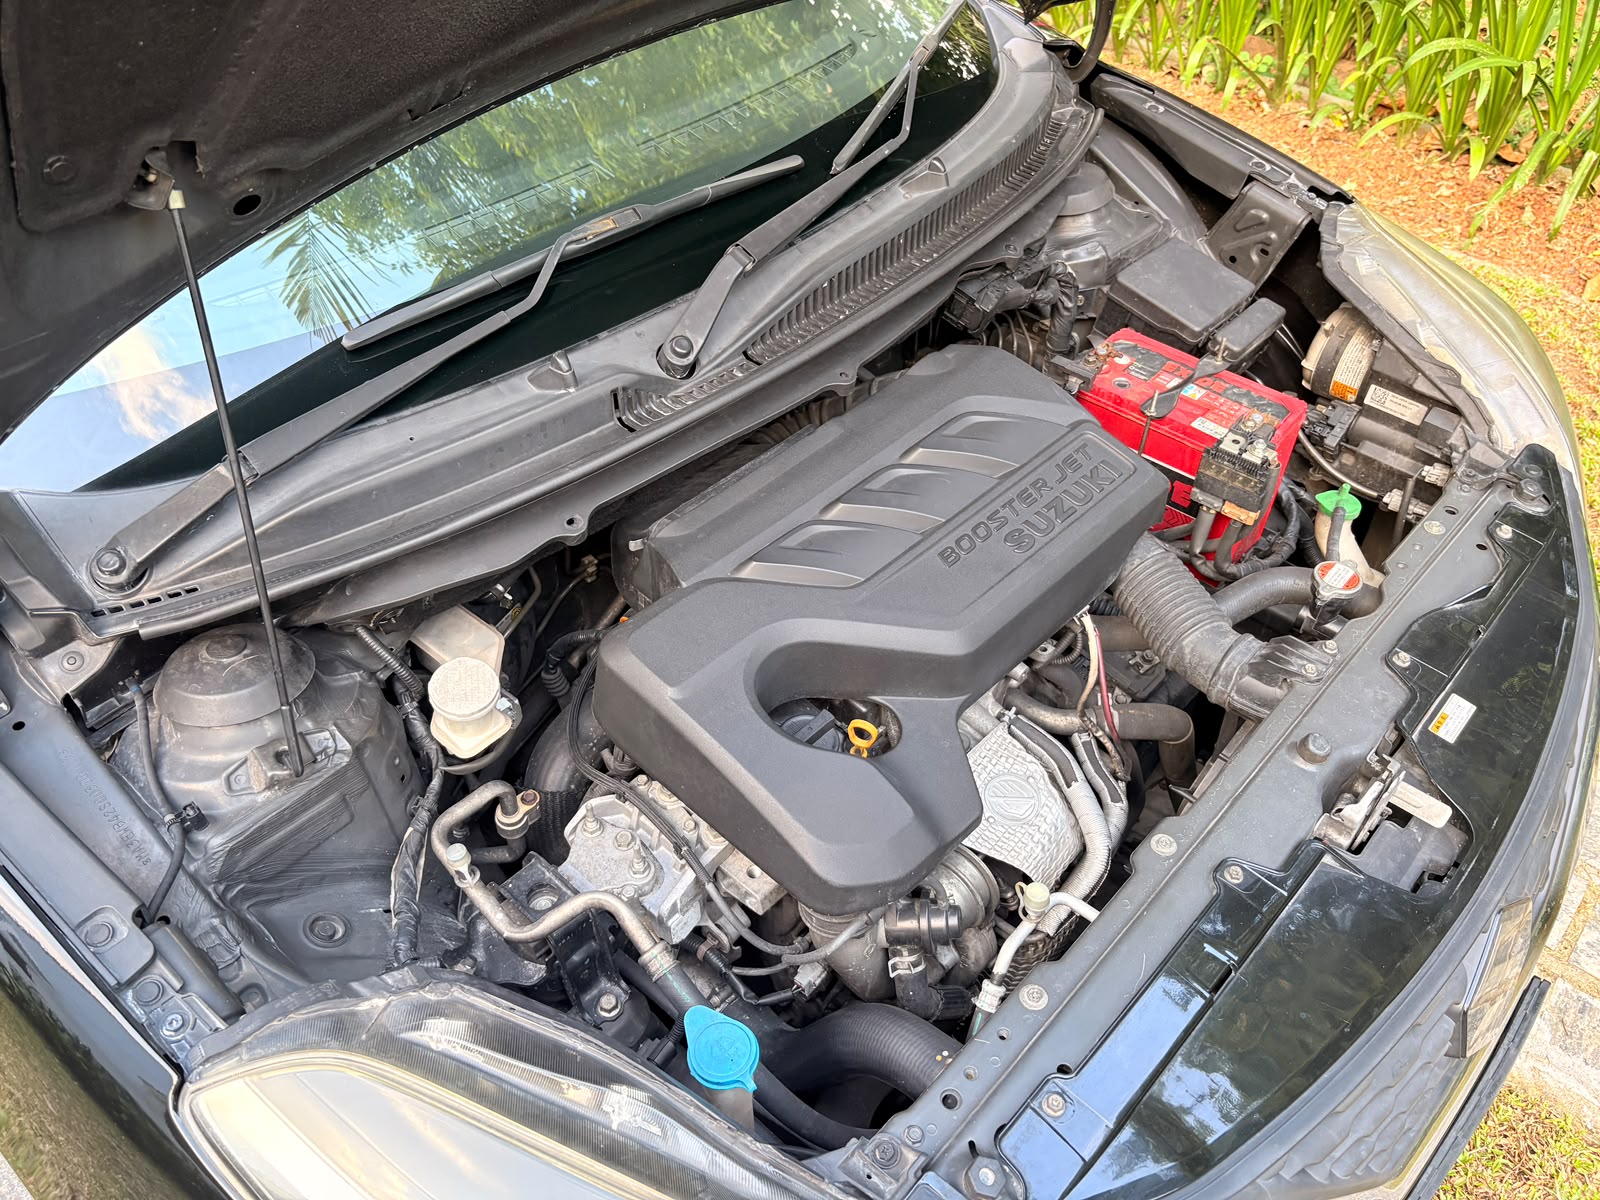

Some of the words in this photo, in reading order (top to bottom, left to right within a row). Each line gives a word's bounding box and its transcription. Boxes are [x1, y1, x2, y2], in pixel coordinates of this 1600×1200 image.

[1162, 361, 1229, 393] EXDE
[937, 477, 1053, 569] BOOSTER
[1054, 443, 1093, 484] JET
[1003, 459, 1123, 554] SUZUKI
